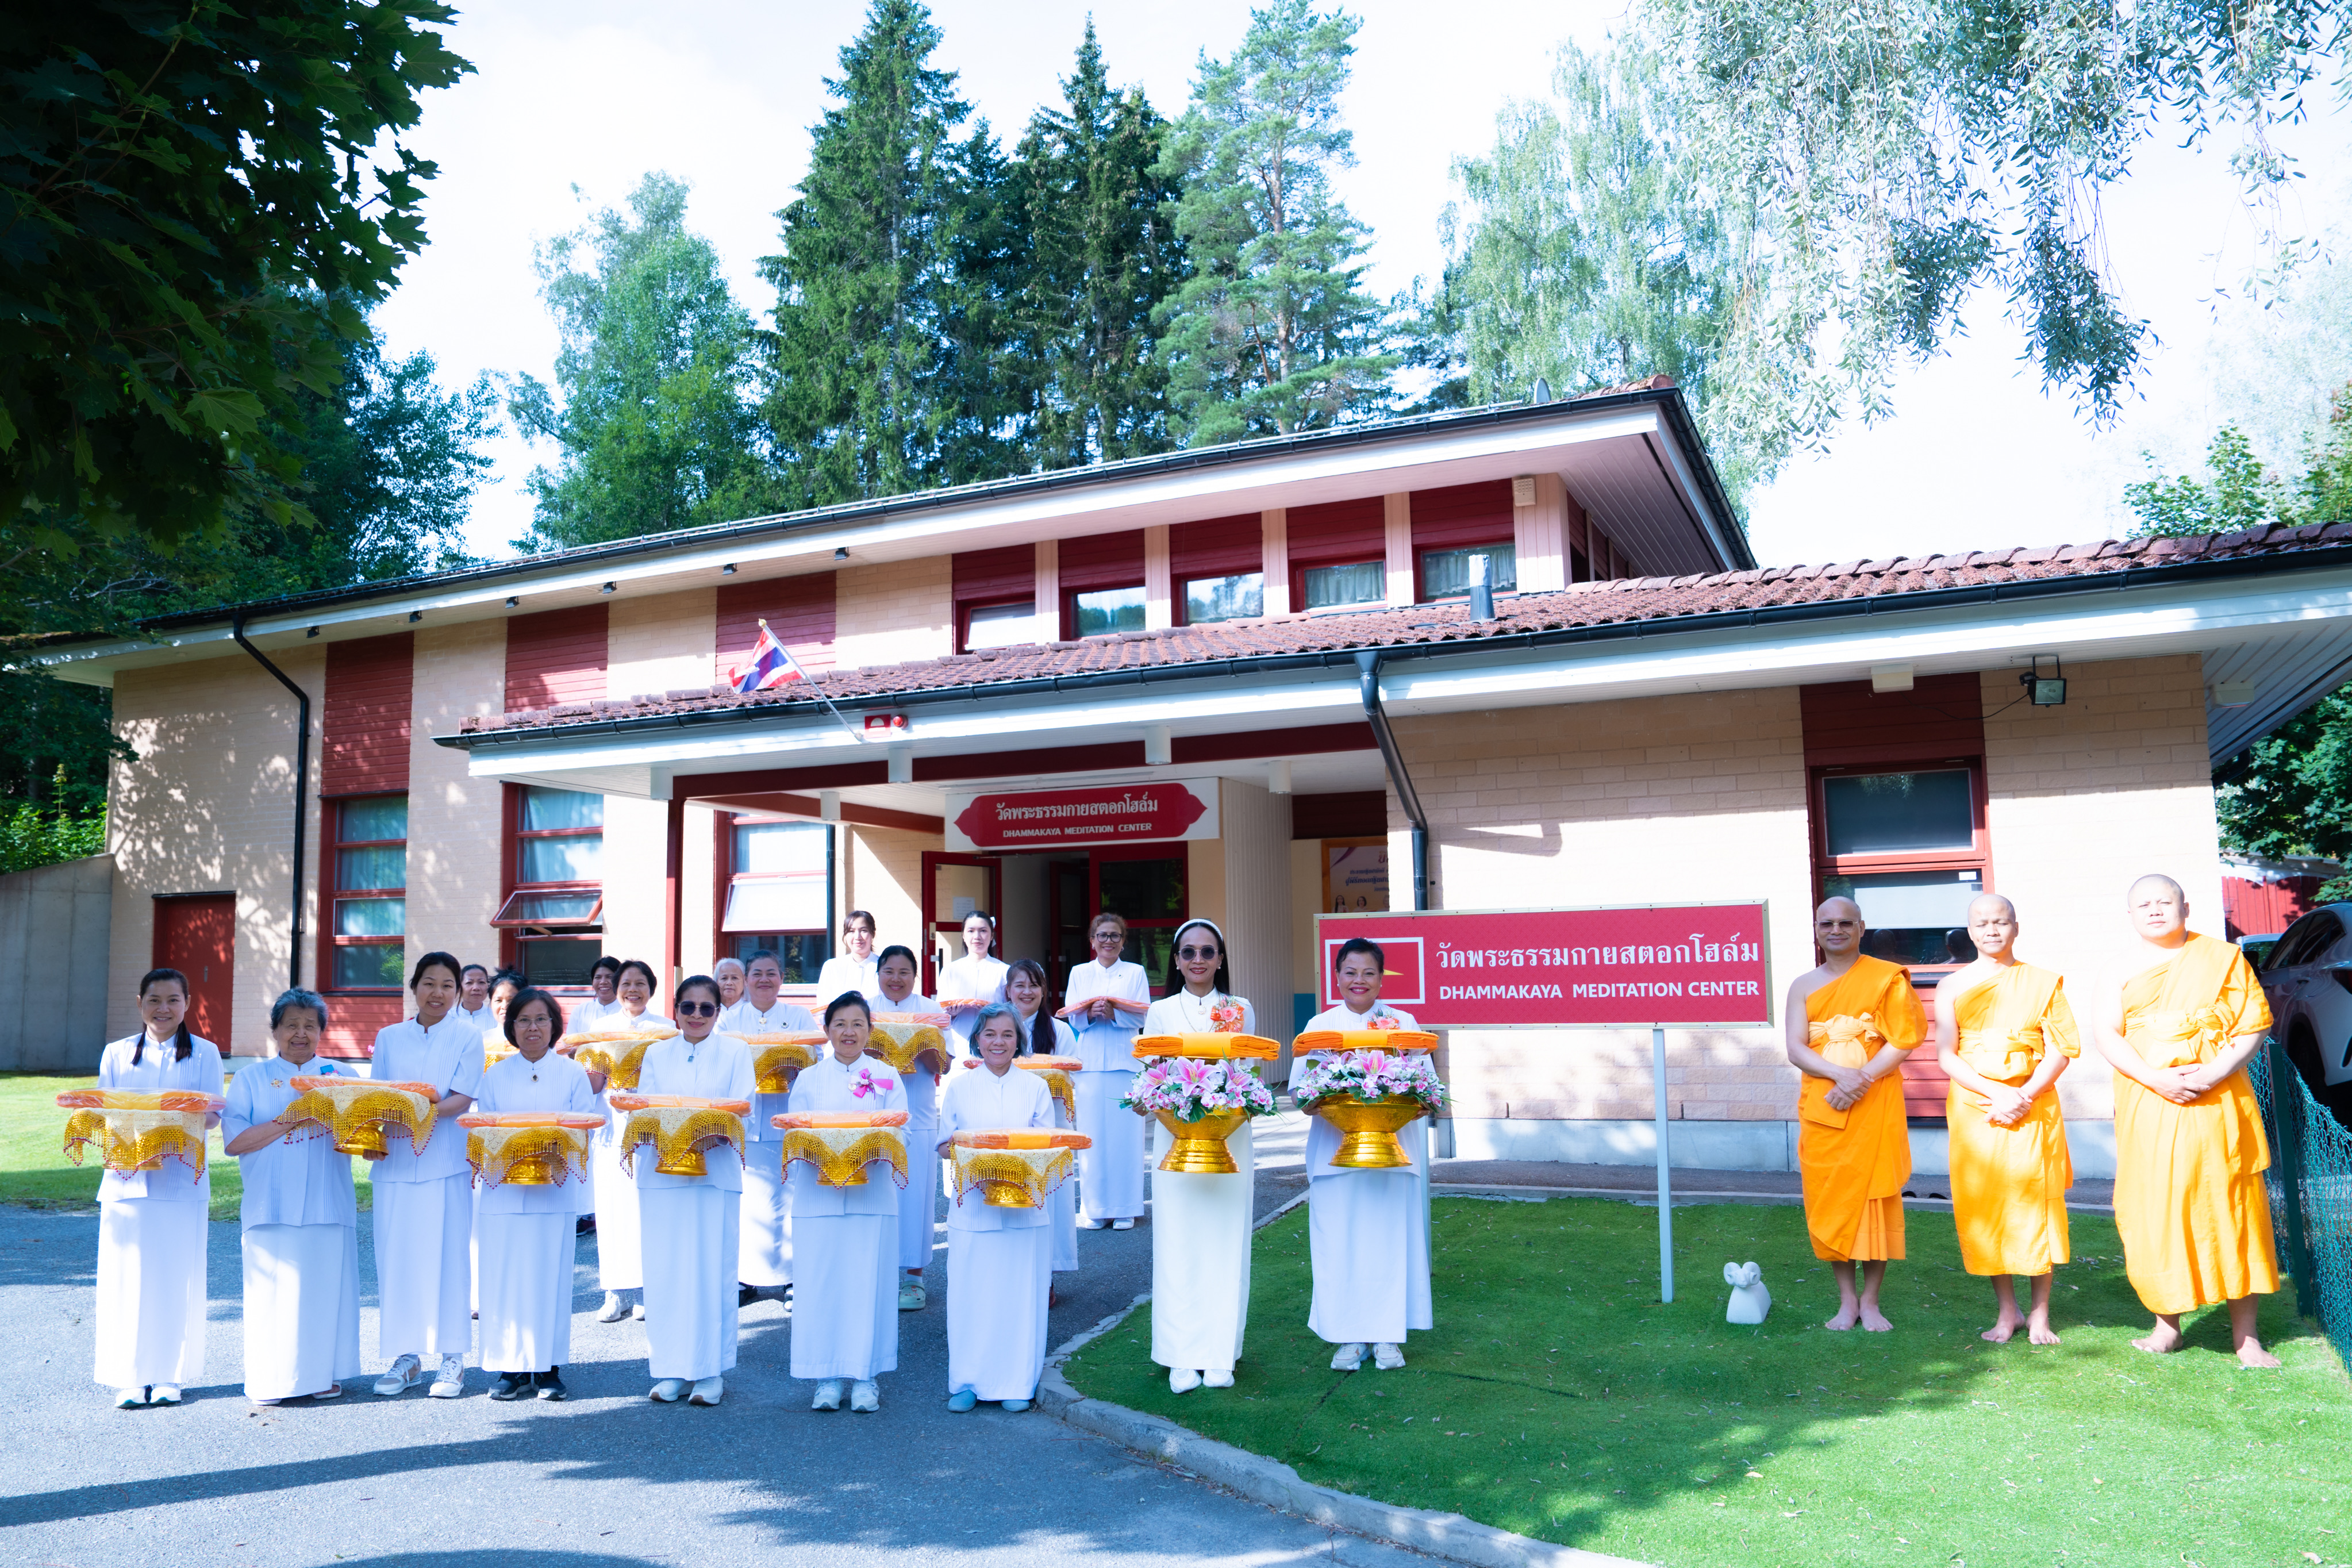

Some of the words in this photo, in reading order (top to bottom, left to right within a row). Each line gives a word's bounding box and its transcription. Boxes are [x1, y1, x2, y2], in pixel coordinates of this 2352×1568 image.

[996, 791, 1158, 821] วัดพระธรรมกายสตอกโฮล์ม
[1003, 828, 1062, 837] DHAMMAKAYA
[1064, 825, 1114, 835] MEDITATION
[1118, 823, 1152, 832] CENTER
[1436, 932, 1758, 968] วัดพระธรรมกายสตอกโฮล์ม
[1440, 984, 1563, 1000] DHAMMAKAYA
[1573, 982, 1682, 998] MEDITATION
[1688, 981, 1759, 997] CENTER
